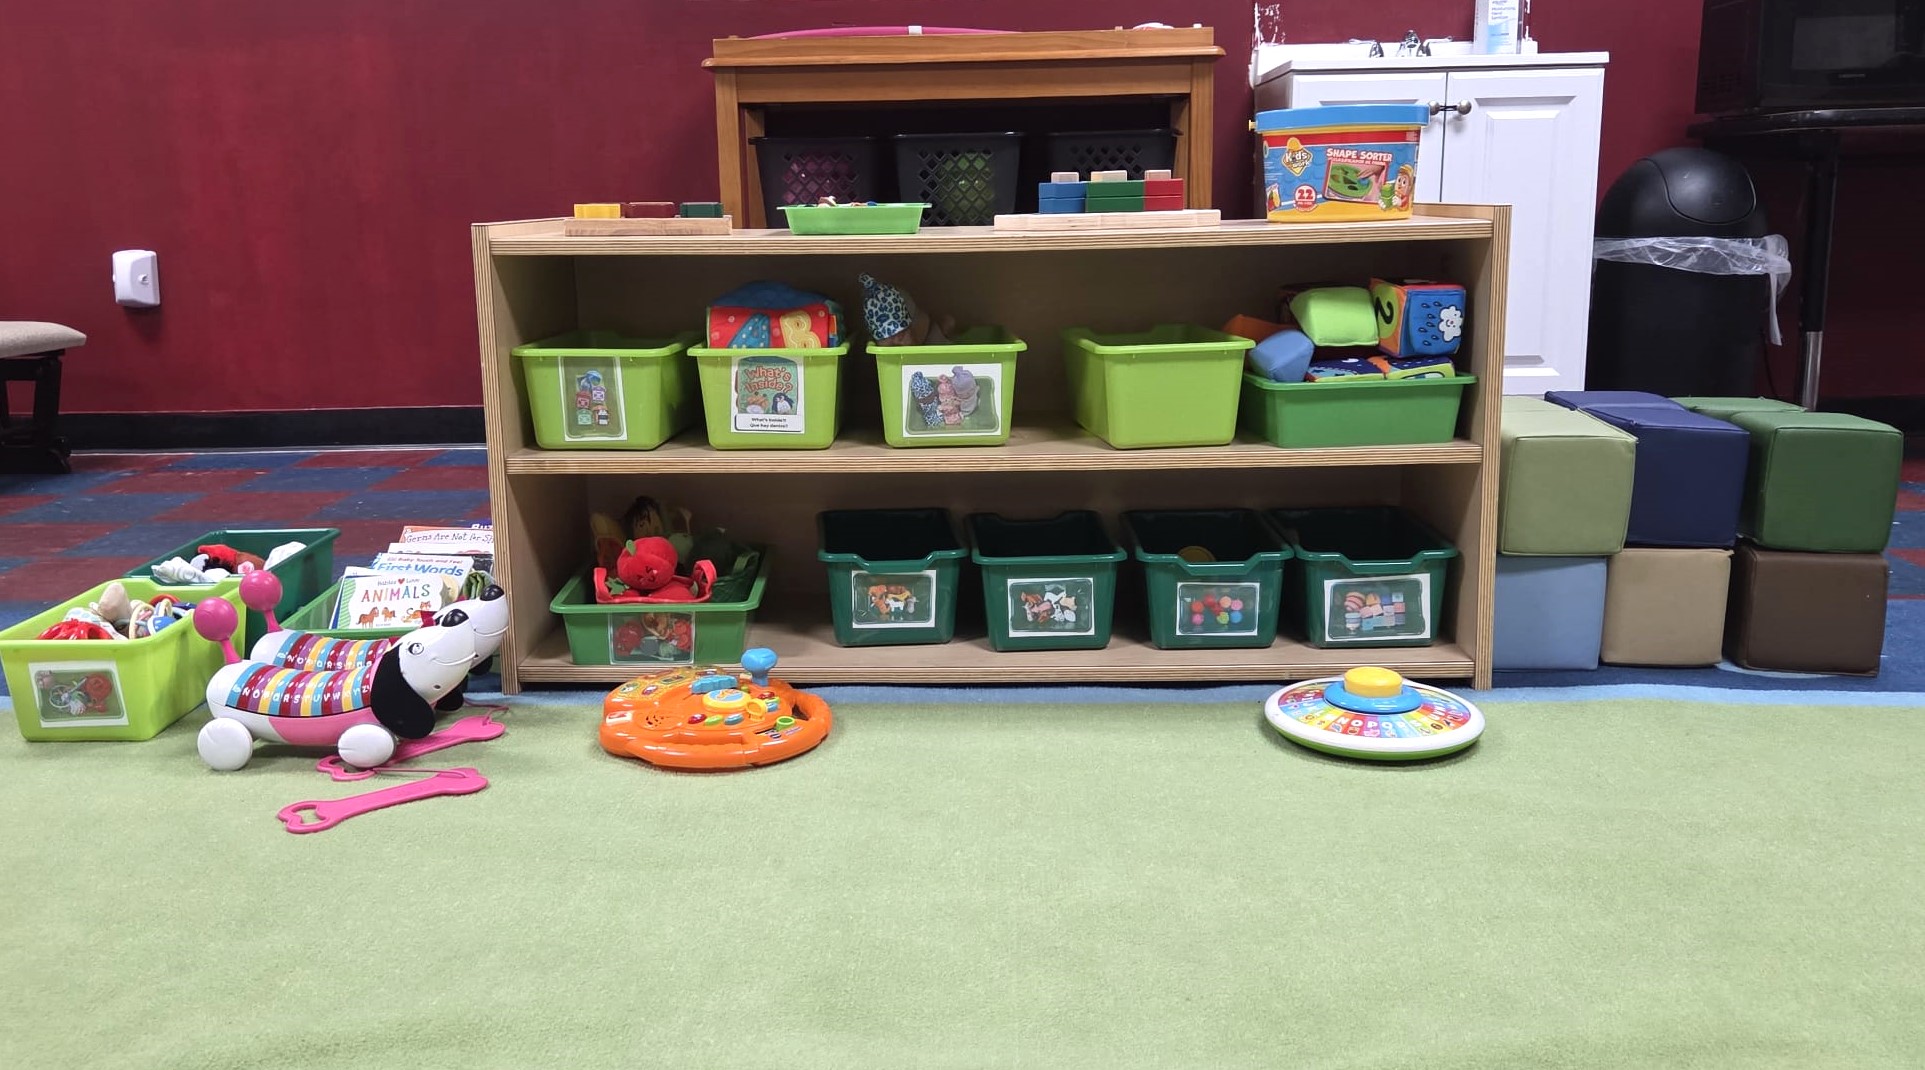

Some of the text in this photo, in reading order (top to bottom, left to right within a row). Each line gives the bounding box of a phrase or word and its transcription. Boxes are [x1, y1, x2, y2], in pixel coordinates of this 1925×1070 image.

[1326, 148, 1392, 162] SHAPE SORTER
[1297, 189, 1313, 200] 22
[745, 365, 791, 381] What's
[745, 378, 793, 393] Inside?
[406, 534, 432, 544] Germs
[433, 532, 450, 541] Are
[451, 532, 468, 541] Not
[377, 561, 412, 572] First
[414, 564, 464, 577] Words
[361, 584, 431, 603] ANIMALS
